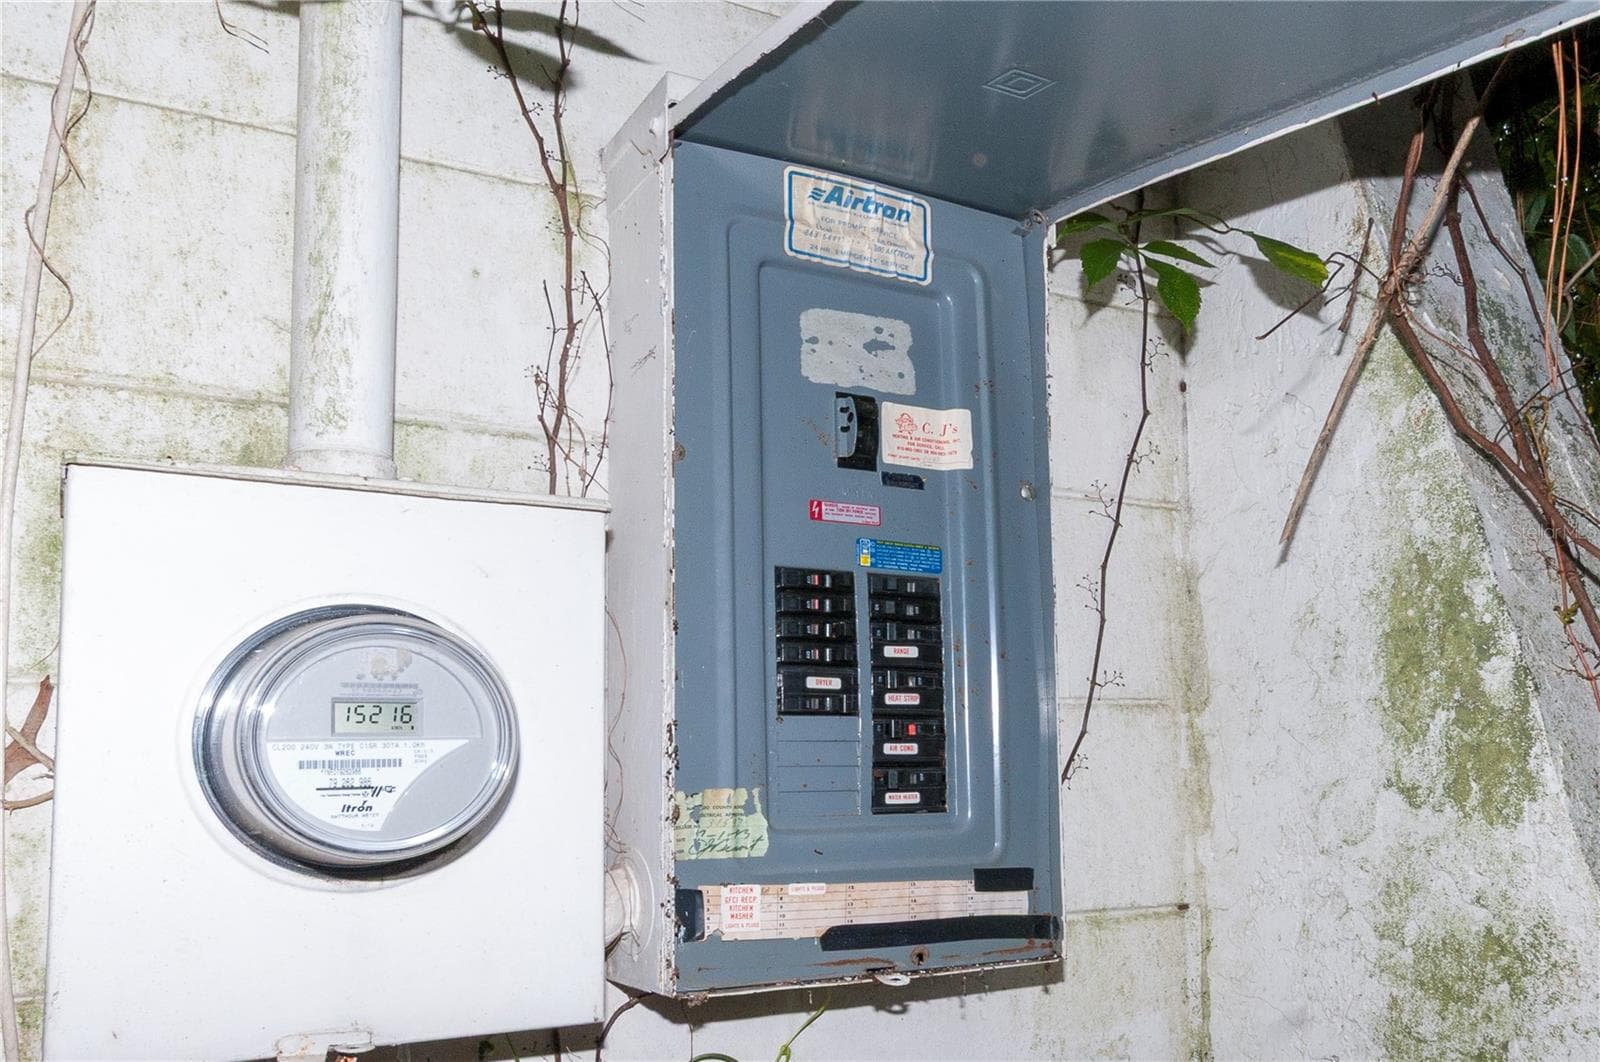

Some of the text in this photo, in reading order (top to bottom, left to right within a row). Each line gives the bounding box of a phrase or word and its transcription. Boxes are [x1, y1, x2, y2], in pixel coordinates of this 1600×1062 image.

[823, 185, 911, 223] Airtron
[815, 678, 833, 687] DRYER
[887, 694, 919, 702] HEAT STRIP
[346, 704, 413, 724] 15216
[338, 743, 354, 751] TYPE
[889, 744, 898, 752] AIR
